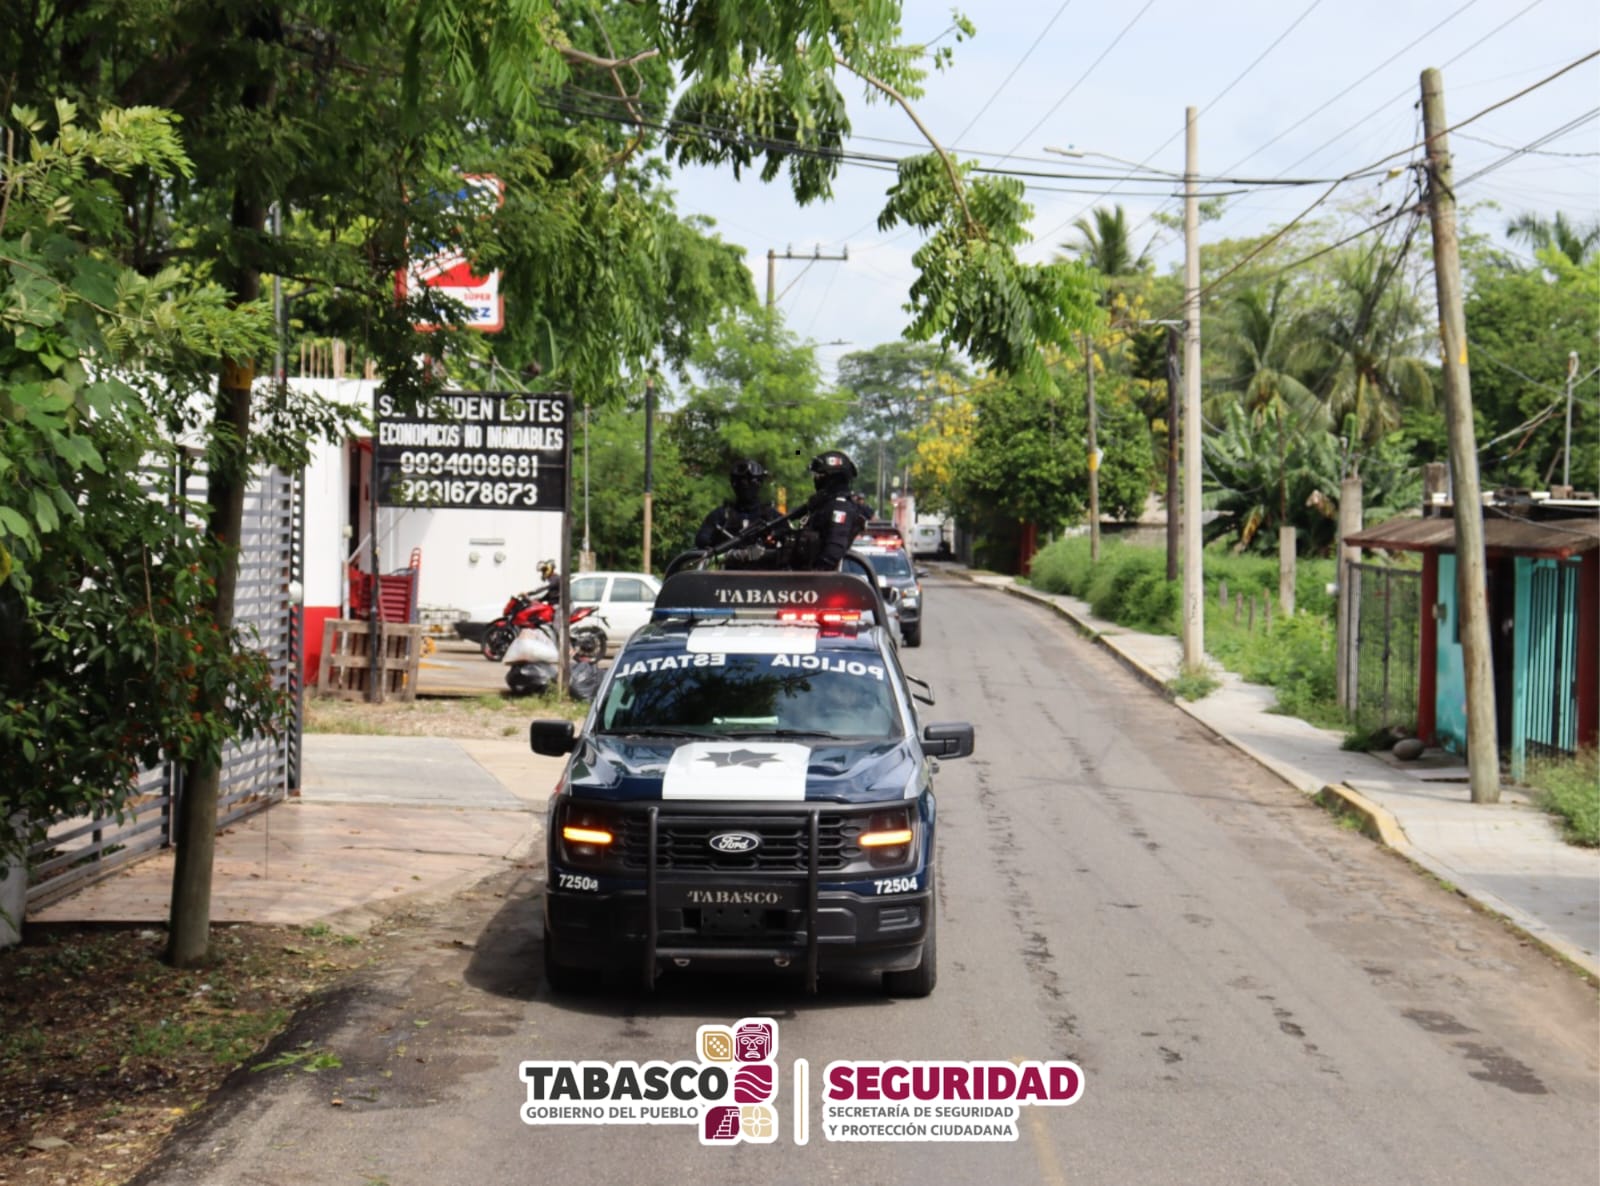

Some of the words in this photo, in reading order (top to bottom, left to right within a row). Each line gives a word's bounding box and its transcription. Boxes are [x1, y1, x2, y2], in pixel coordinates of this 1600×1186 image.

[379, 395, 406, 418] S
[379, 422, 460, 447] ECONOMICOS
[464, 425, 482, 448] NO
[400, 452, 538, 477] 9934008681
[401, 480, 538, 505] 9931678673
[714, 589, 819, 604] TABASCO
[688, 890, 779, 904] TABASCO
[874, 876, 918, 895] 72504
